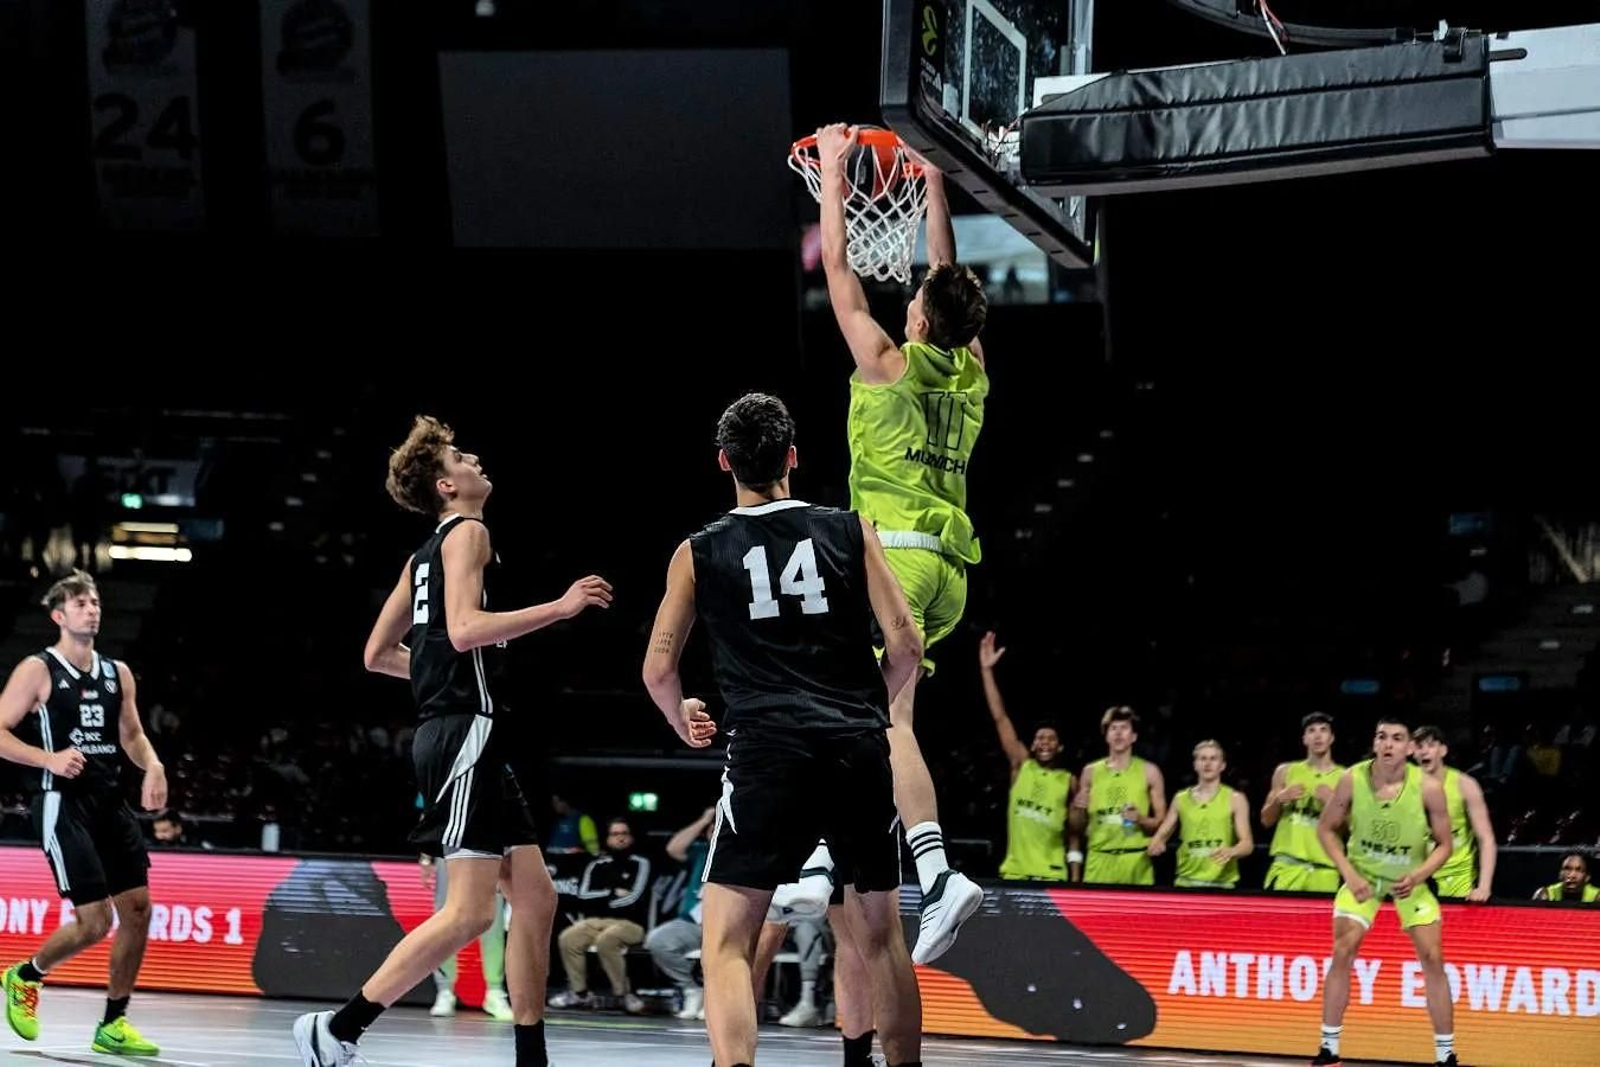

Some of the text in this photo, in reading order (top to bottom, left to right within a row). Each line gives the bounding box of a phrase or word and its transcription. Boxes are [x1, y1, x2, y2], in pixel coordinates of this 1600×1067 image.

[96, 94, 198, 160] 24
[294, 101, 344, 165] 6
[413, 562, 431, 626] 2
[742, 537, 830, 620] 14
[78, 703, 105, 728] 23
[1361, 840, 1412, 855] NEXT
[223, 907, 244, 945] 1
[1167, 949, 1383, 1006] ANTHOY
